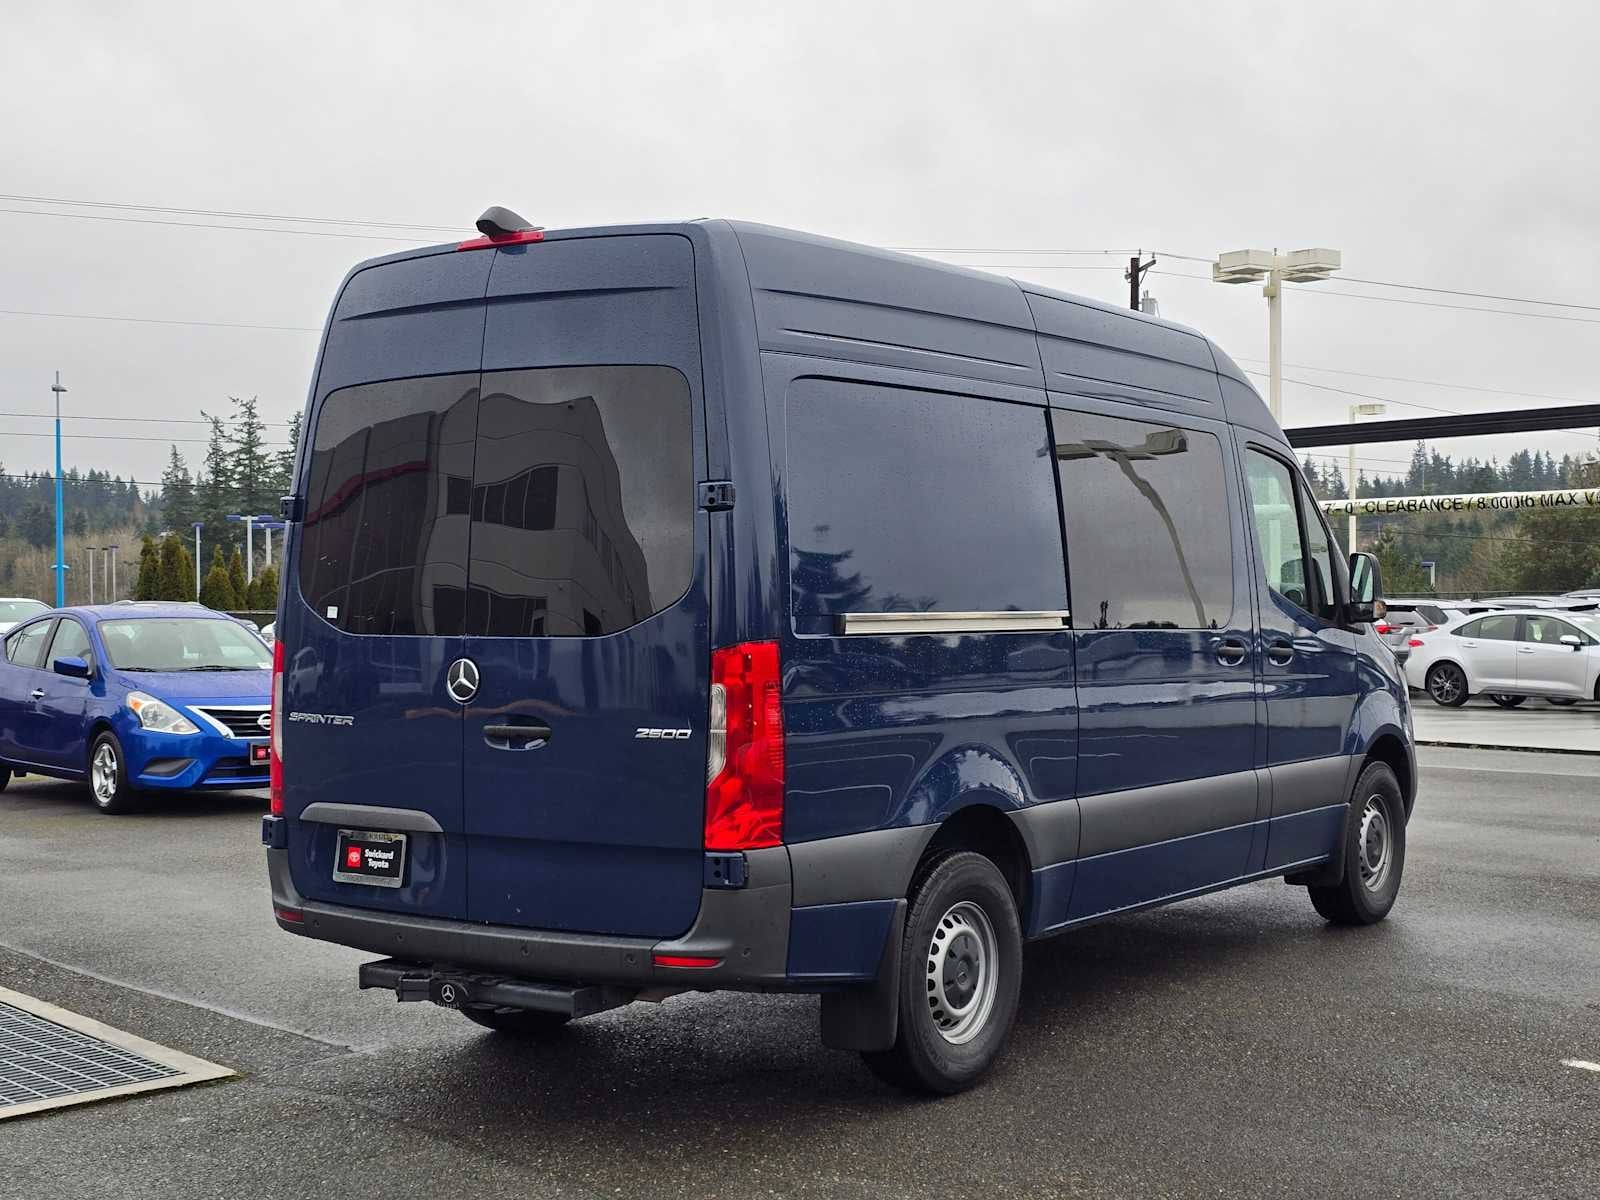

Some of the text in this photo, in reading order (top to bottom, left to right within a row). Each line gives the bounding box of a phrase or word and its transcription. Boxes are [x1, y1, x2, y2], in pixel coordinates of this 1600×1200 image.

[1365, 497, 1464, 513] CLEARANCE
[1540, 491, 1579, 507] MAX
[288, 711, 355, 726] SPRINTER
[635, 727, 693, 740] 2500
[367, 858, 390, 870] Toyota
